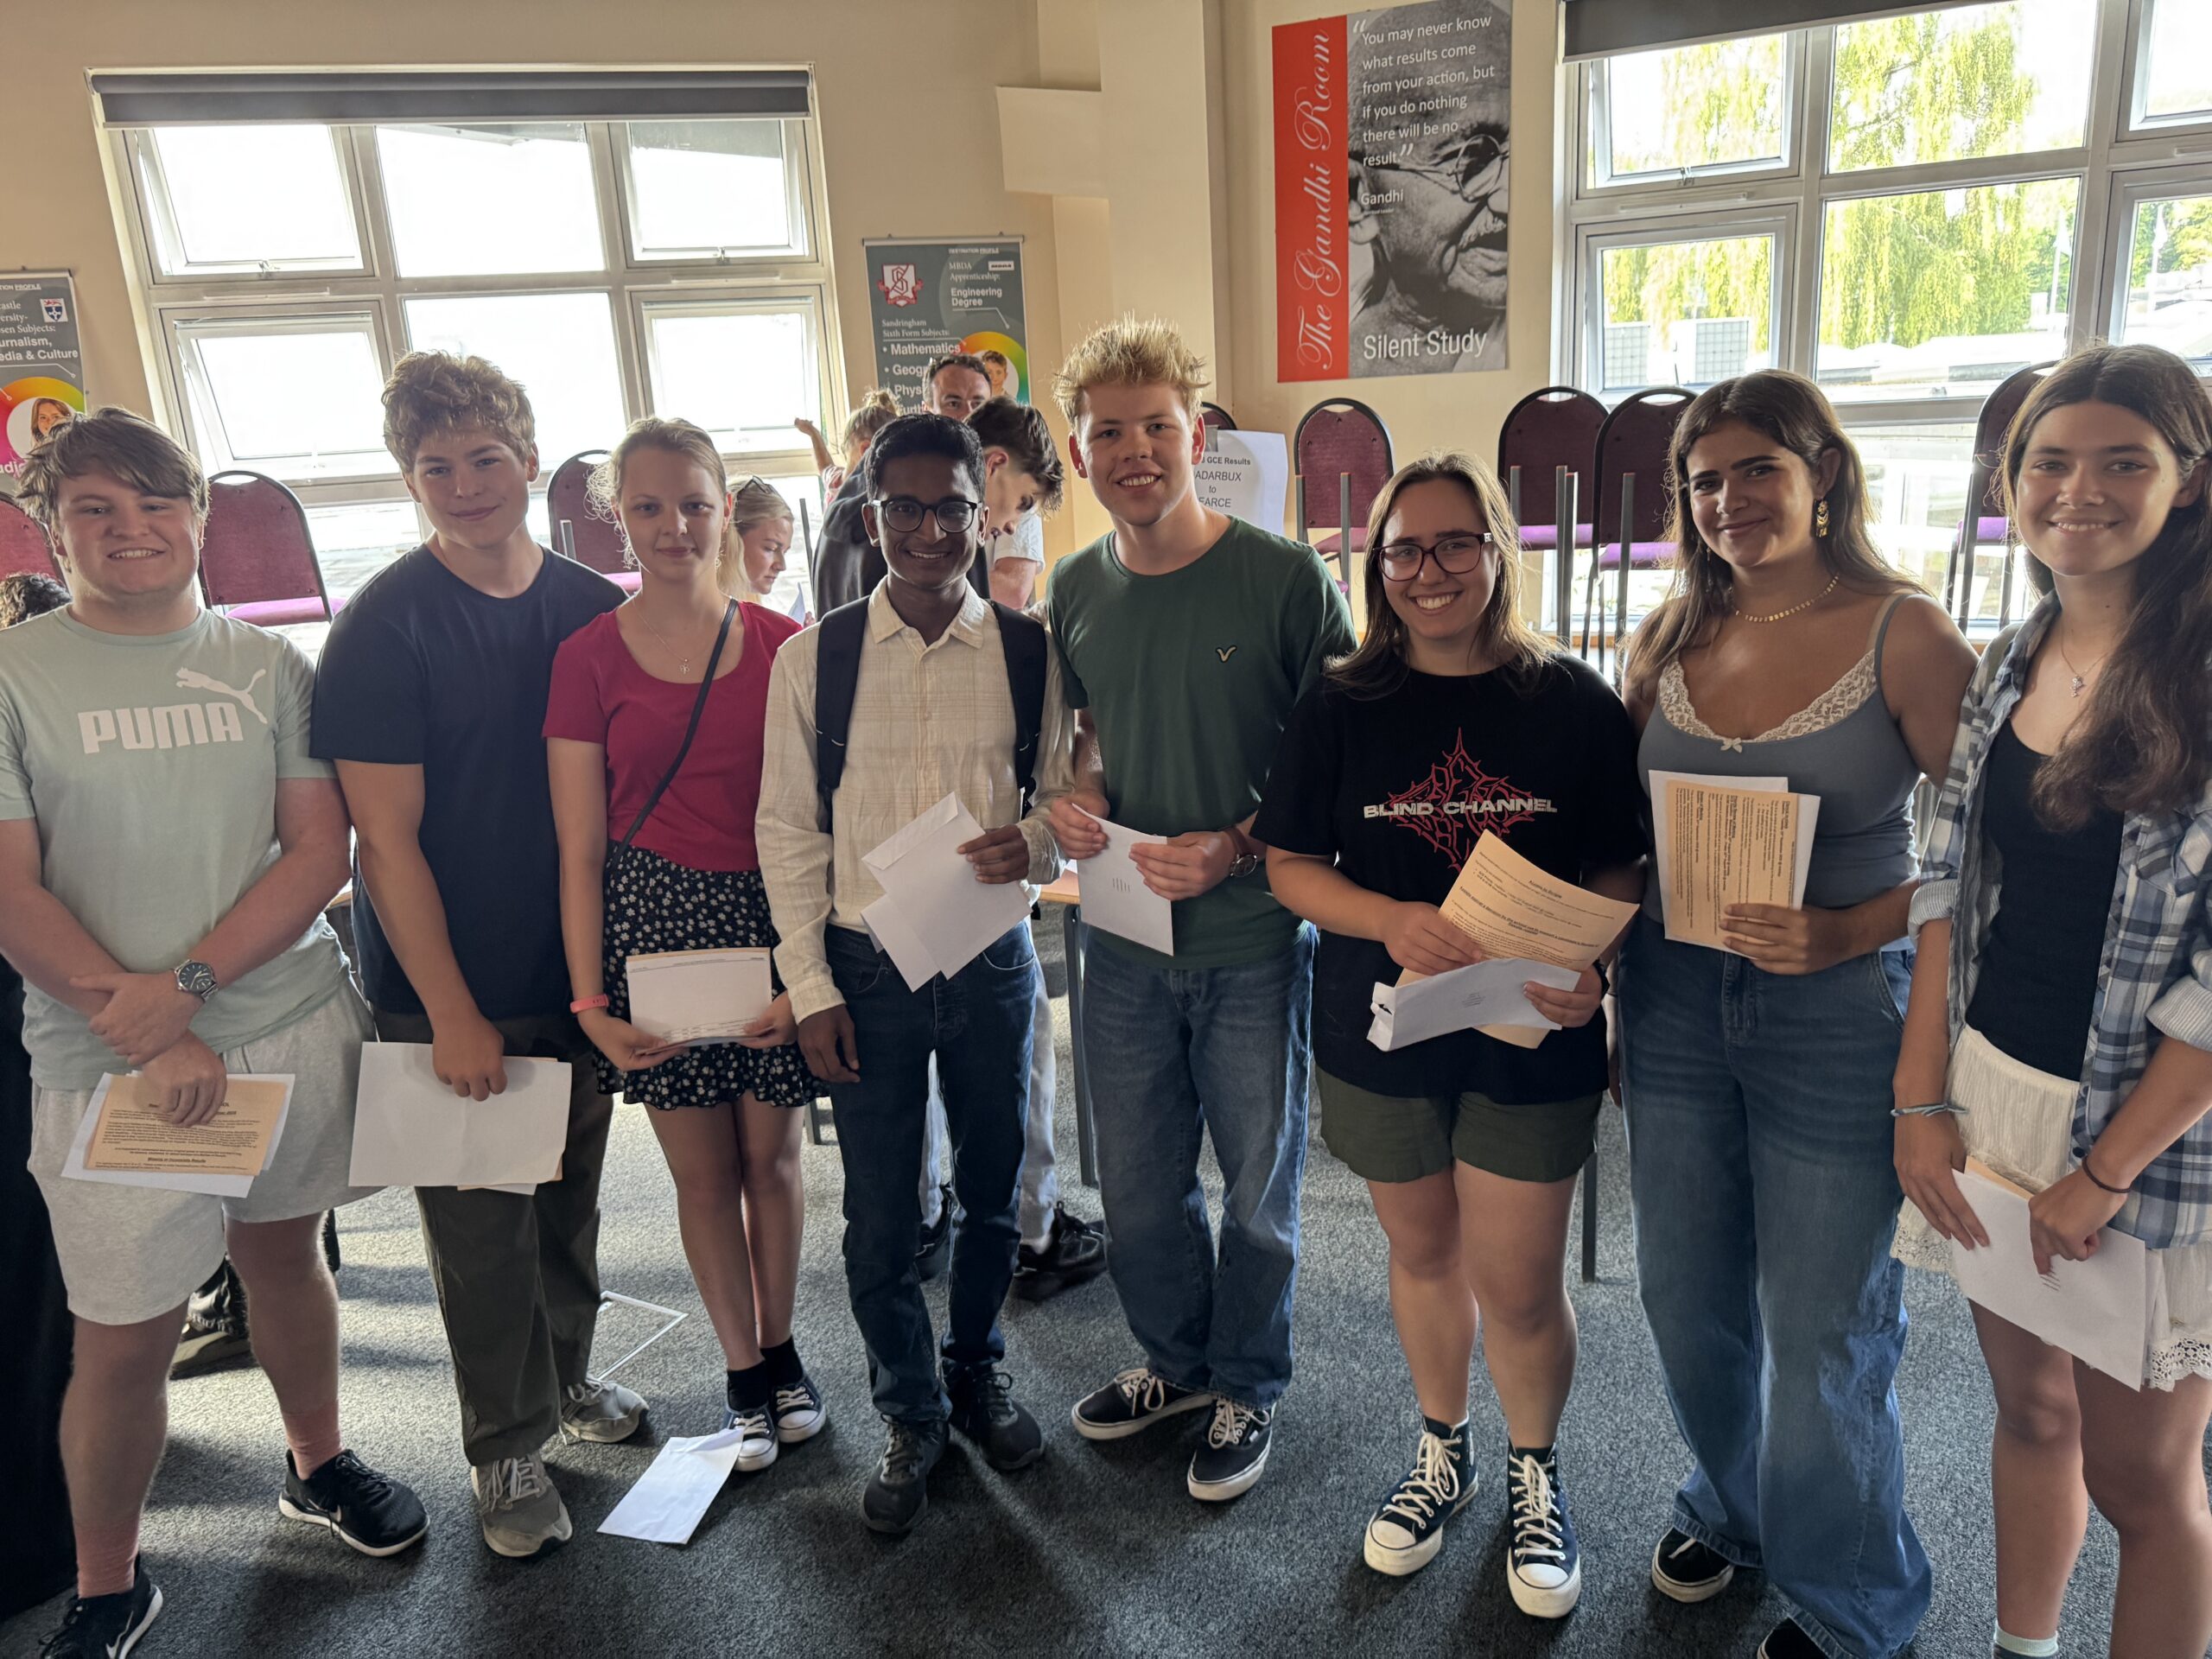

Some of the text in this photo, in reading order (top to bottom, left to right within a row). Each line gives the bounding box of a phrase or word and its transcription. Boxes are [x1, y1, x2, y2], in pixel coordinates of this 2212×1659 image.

[1388, 29, 1414, 41] may
[1418, 22, 1453, 40] never
[1457, 16, 1492, 31] know
[1363, 44, 1476, 70] what results come
[1363, 65, 1495, 94] from your action, but
[1363, 95, 1467, 120] if you do nothing
[1363, 122, 1459, 143] there will be no
[1294, 29, 1341, 371] The Gandhi Room
[1361, 188, 1403, 206] Gandhi
[950, 287, 1002, 297] Engineering
[951, 297, 983, 308] Degree
[17, 323, 56, 336] Subjects:
[881, 319, 927, 329] Sandringham
[891, 343, 962, 355] Mathematics
[1363, 327, 1487, 359] Silent Study
[26, 350, 35, 360] &
[36, 348, 79, 360] Culture
[1224, 457, 1251, 466] Results
[1194, 471, 1242, 481] ADARBUX
[78, 702, 244, 753] PUMA
[1363, 798, 1558, 819] BLIND CHANNEL
